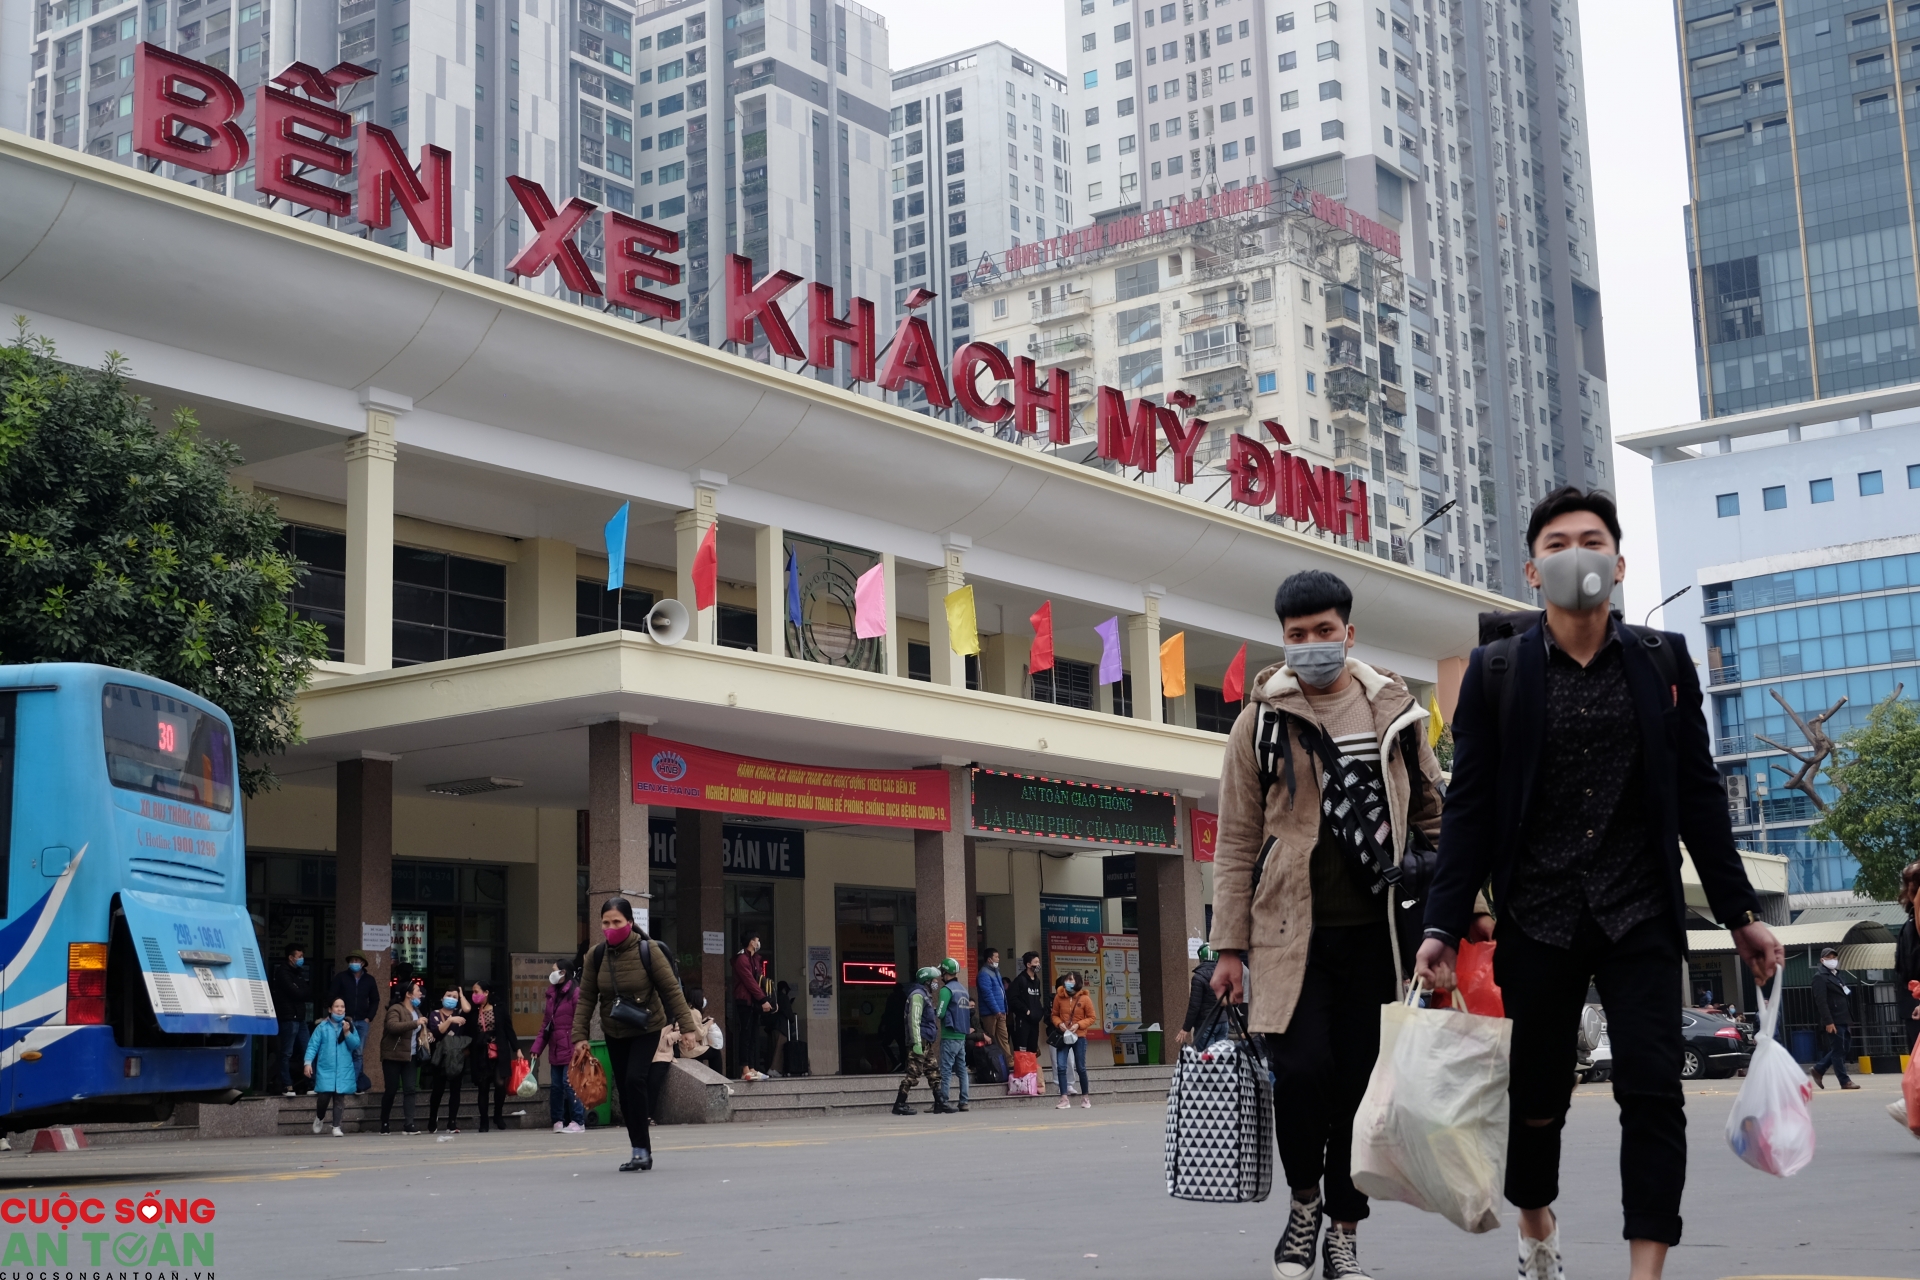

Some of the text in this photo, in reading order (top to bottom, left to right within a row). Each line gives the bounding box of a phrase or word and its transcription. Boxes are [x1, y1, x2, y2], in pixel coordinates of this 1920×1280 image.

[1005, 242, 1039, 273] CÔNG
[1042, 238, 1058, 262] TY
[1061, 231, 1078, 258] CP
[1082, 222, 1104, 252] XÂY
[1149, 209, 1167, 238] HẠ
[1211, 186, 1249, 218] SÔNG
[1253, 177, 1272, 208] ĐÀ
[1349, 209, 1401, 260] TOWER
[133, 41, 1370, 543] BẾN XE KHÁCH MỸ ĐÌNH
[158, 722, 174, 752] 30
[659, 764, 679, 775] HNB
[805, 771, 824, 786] THAM
[822, 773, 834, 787] GIA
[834, 775, 851, 792] HOẠT
[850, 774, 867, 793] ĐỘNG
[883, 777, 895, 793] CÁC
[895, 776, 908, 795] BẾN
[909, 781, 917, 795] XE
[657, 784, 668, 793] XE
[705, 783, 730, 802] NGHIÊM
[750, 785, 767, 805] CHẤP
[784, 793, 797, 809] ĐEO
[797, 789, 814, 810] KHẨU
[814, 796, 834, 812] TRANG
[834, 793, 843, 812] ĐỂ
[843, 796, 864, 814] PHÒNG
[864, 797, 885, 816] CHỐNG
[885, 802, 900, 820] DỊCH
[900, 801, 917, 821] BỆNH
[917, 805, 947, 821] COVID-19.
[1021, 785, 1133, 812] AN TOÀN GIAO THÔNG
[152, 801, 166, 820] BUS
[193, 810, 211, 831] LONG
[983, 805, 1003, 826] LÀ
[1047, 814, 1083, 834] PHÚC
[1086, 816, 1113, 838] CỦA
[1142, 823, 1168, 843] NHÀ
[145, 831, 217, 858] Hotline 1900.1296
[722, 832, 761, 870] BÁN
[766, 837, 791, 872] VÉ
[398, 922, 425, 932] KHÁCH
[1047, 914, 1089, 925] NỘI QUY BẾN XE
[173, 923, 193, 946] 29B
[407, 933, 422, 945] YẾN
